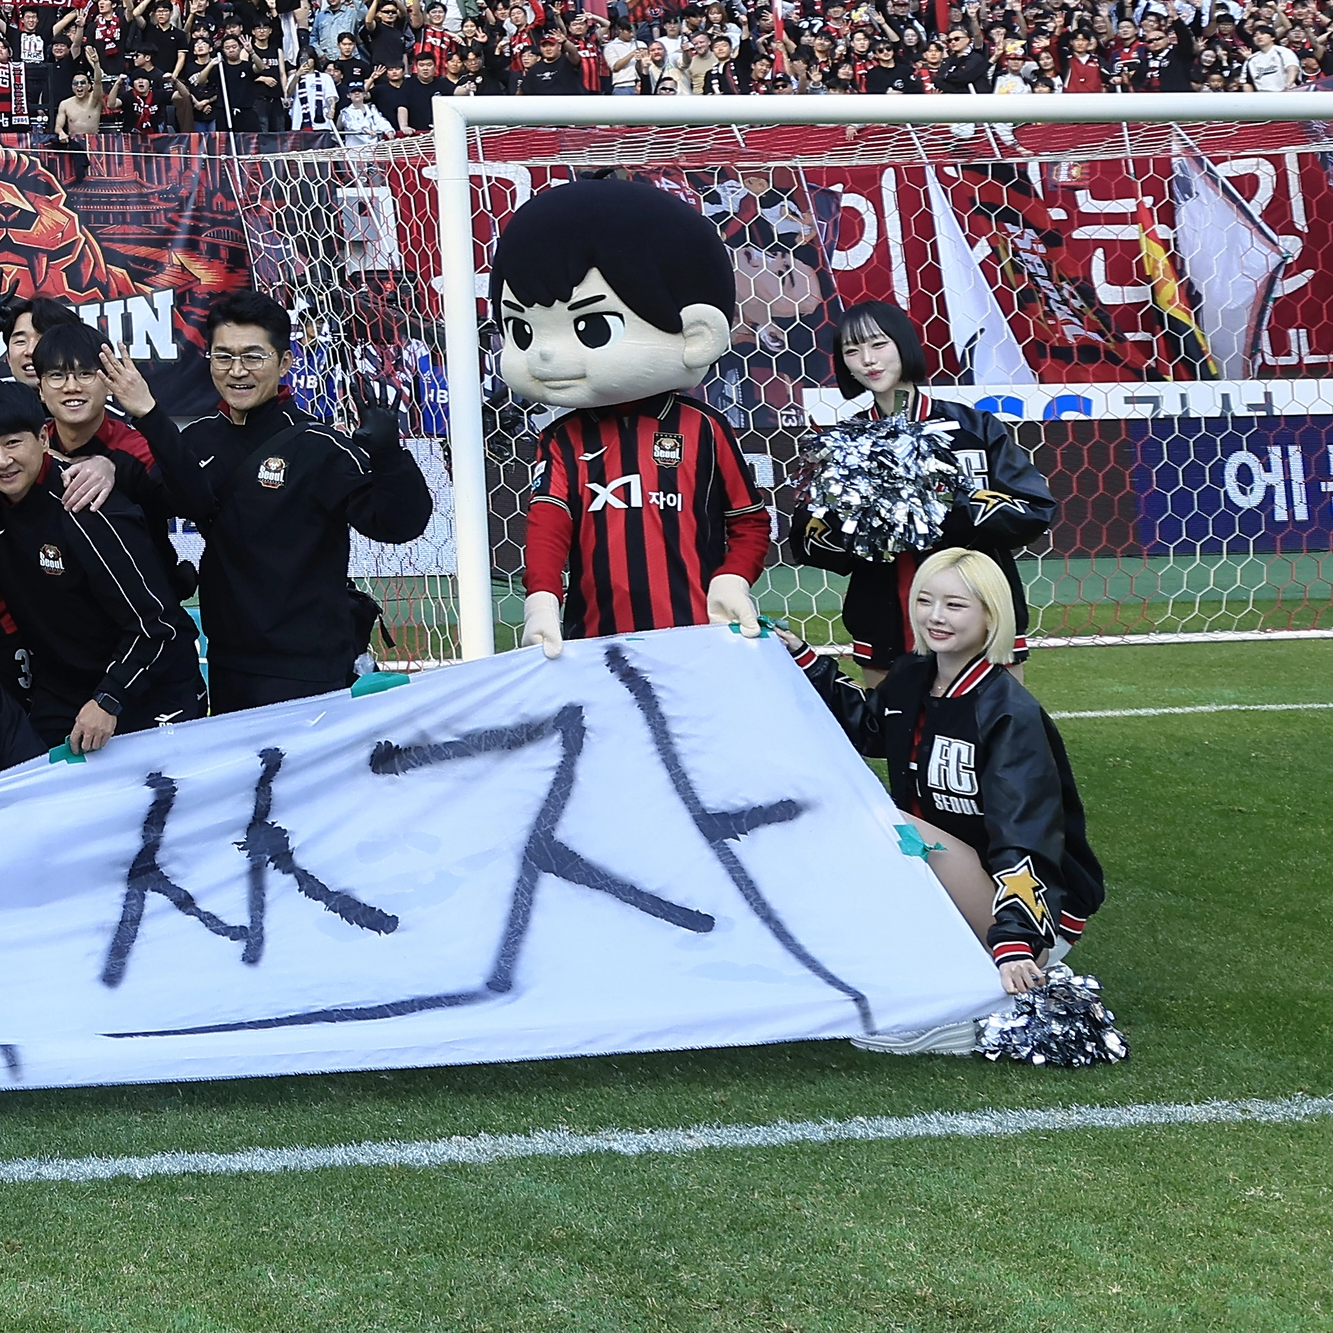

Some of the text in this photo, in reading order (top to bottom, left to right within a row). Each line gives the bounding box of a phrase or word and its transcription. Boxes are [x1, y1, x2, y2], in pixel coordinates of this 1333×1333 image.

[257, 468, 287, 483] Seoul
[648, 491, 683, 512] 자이
[40, 553, 65, 571] Seoul
[927, 735, 979, 796] FC
[933, 791, 985, 816] SEOUL
